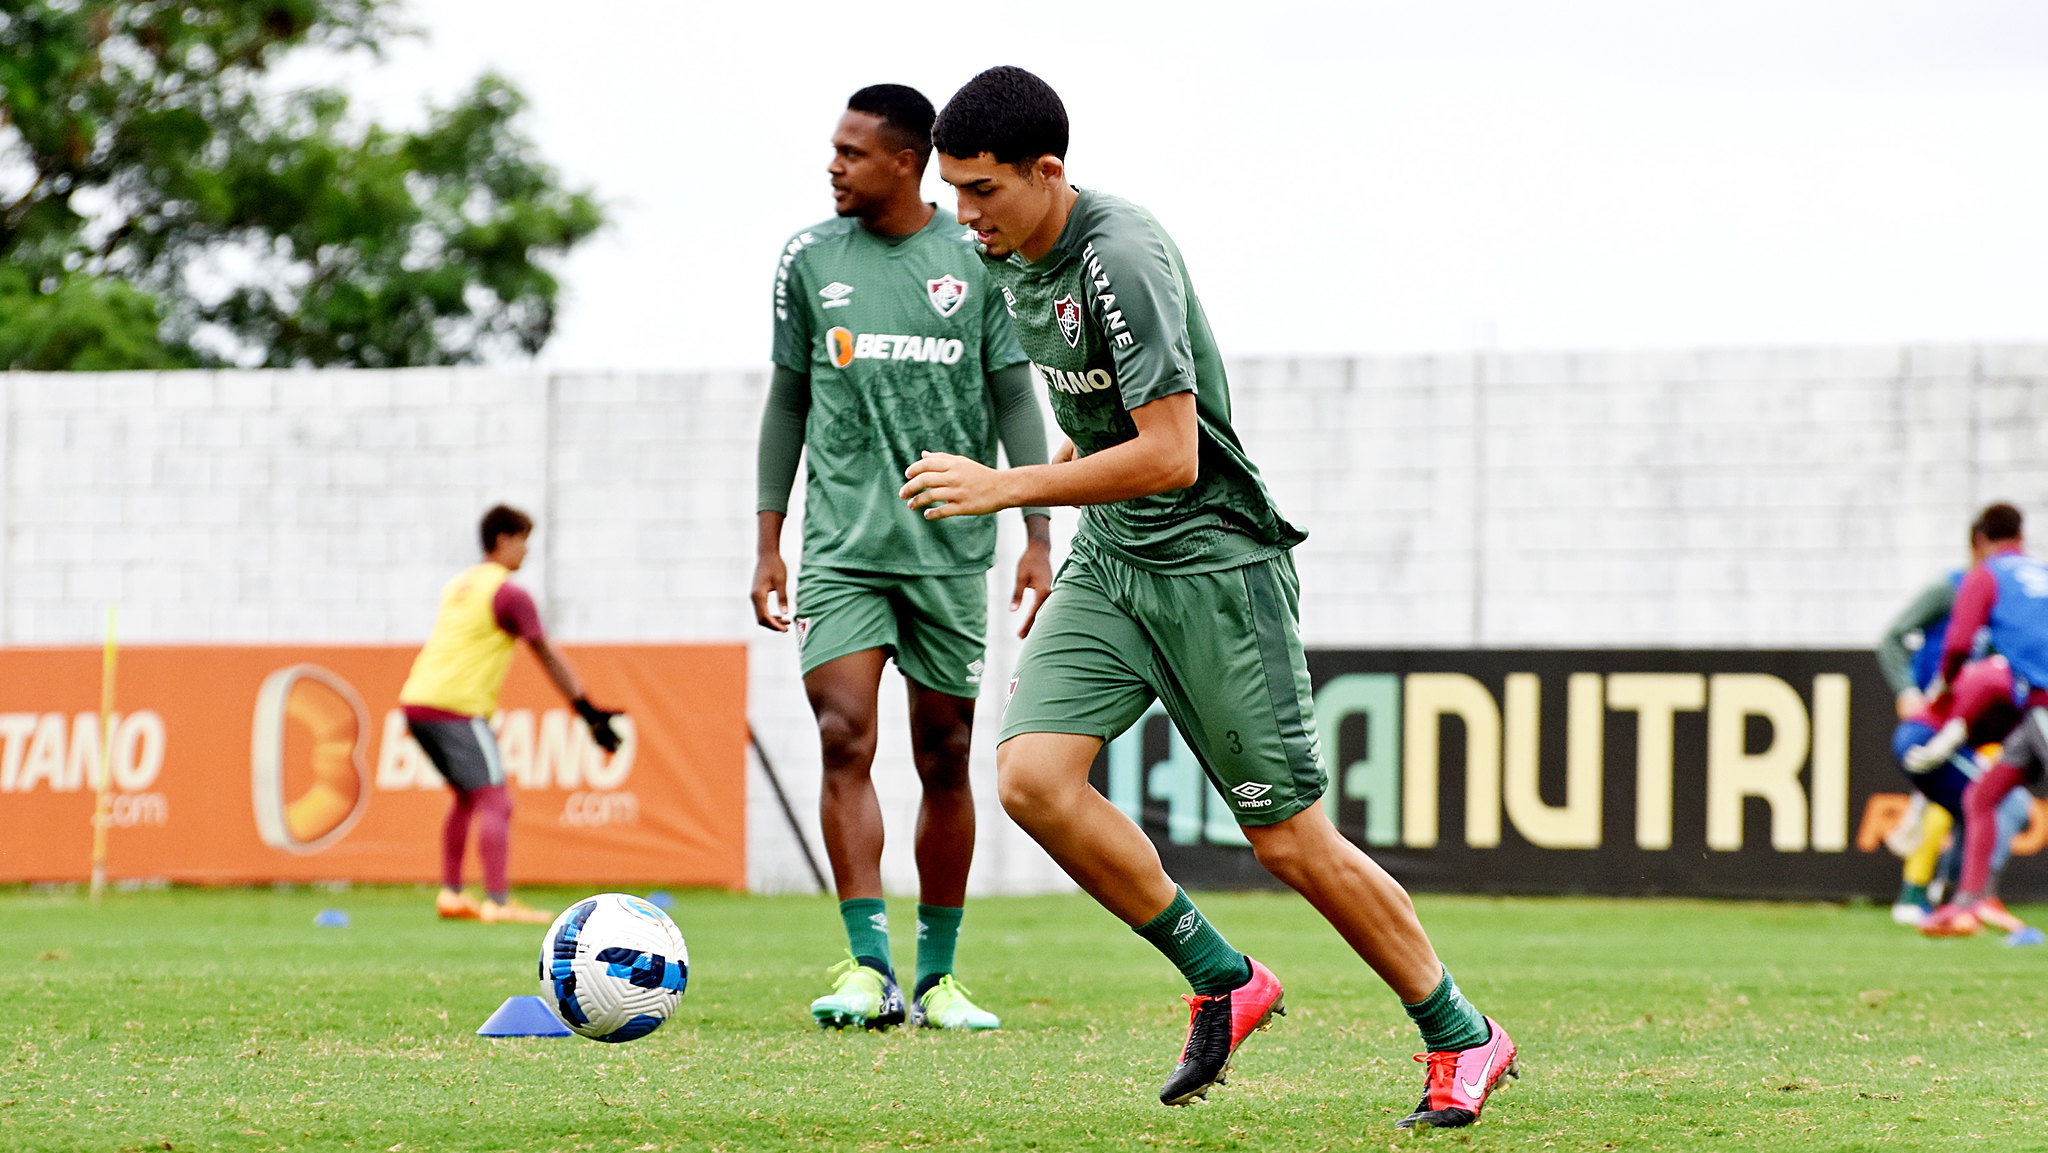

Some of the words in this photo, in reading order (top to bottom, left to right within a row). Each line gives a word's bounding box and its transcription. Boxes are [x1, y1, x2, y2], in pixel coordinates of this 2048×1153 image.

[854, 333, 964, 365] BETANO
[375, 708, 637, 790] BANO
[1226, 730, 1243, 755] 3
[1238, 799, 1272, 808] umbro
